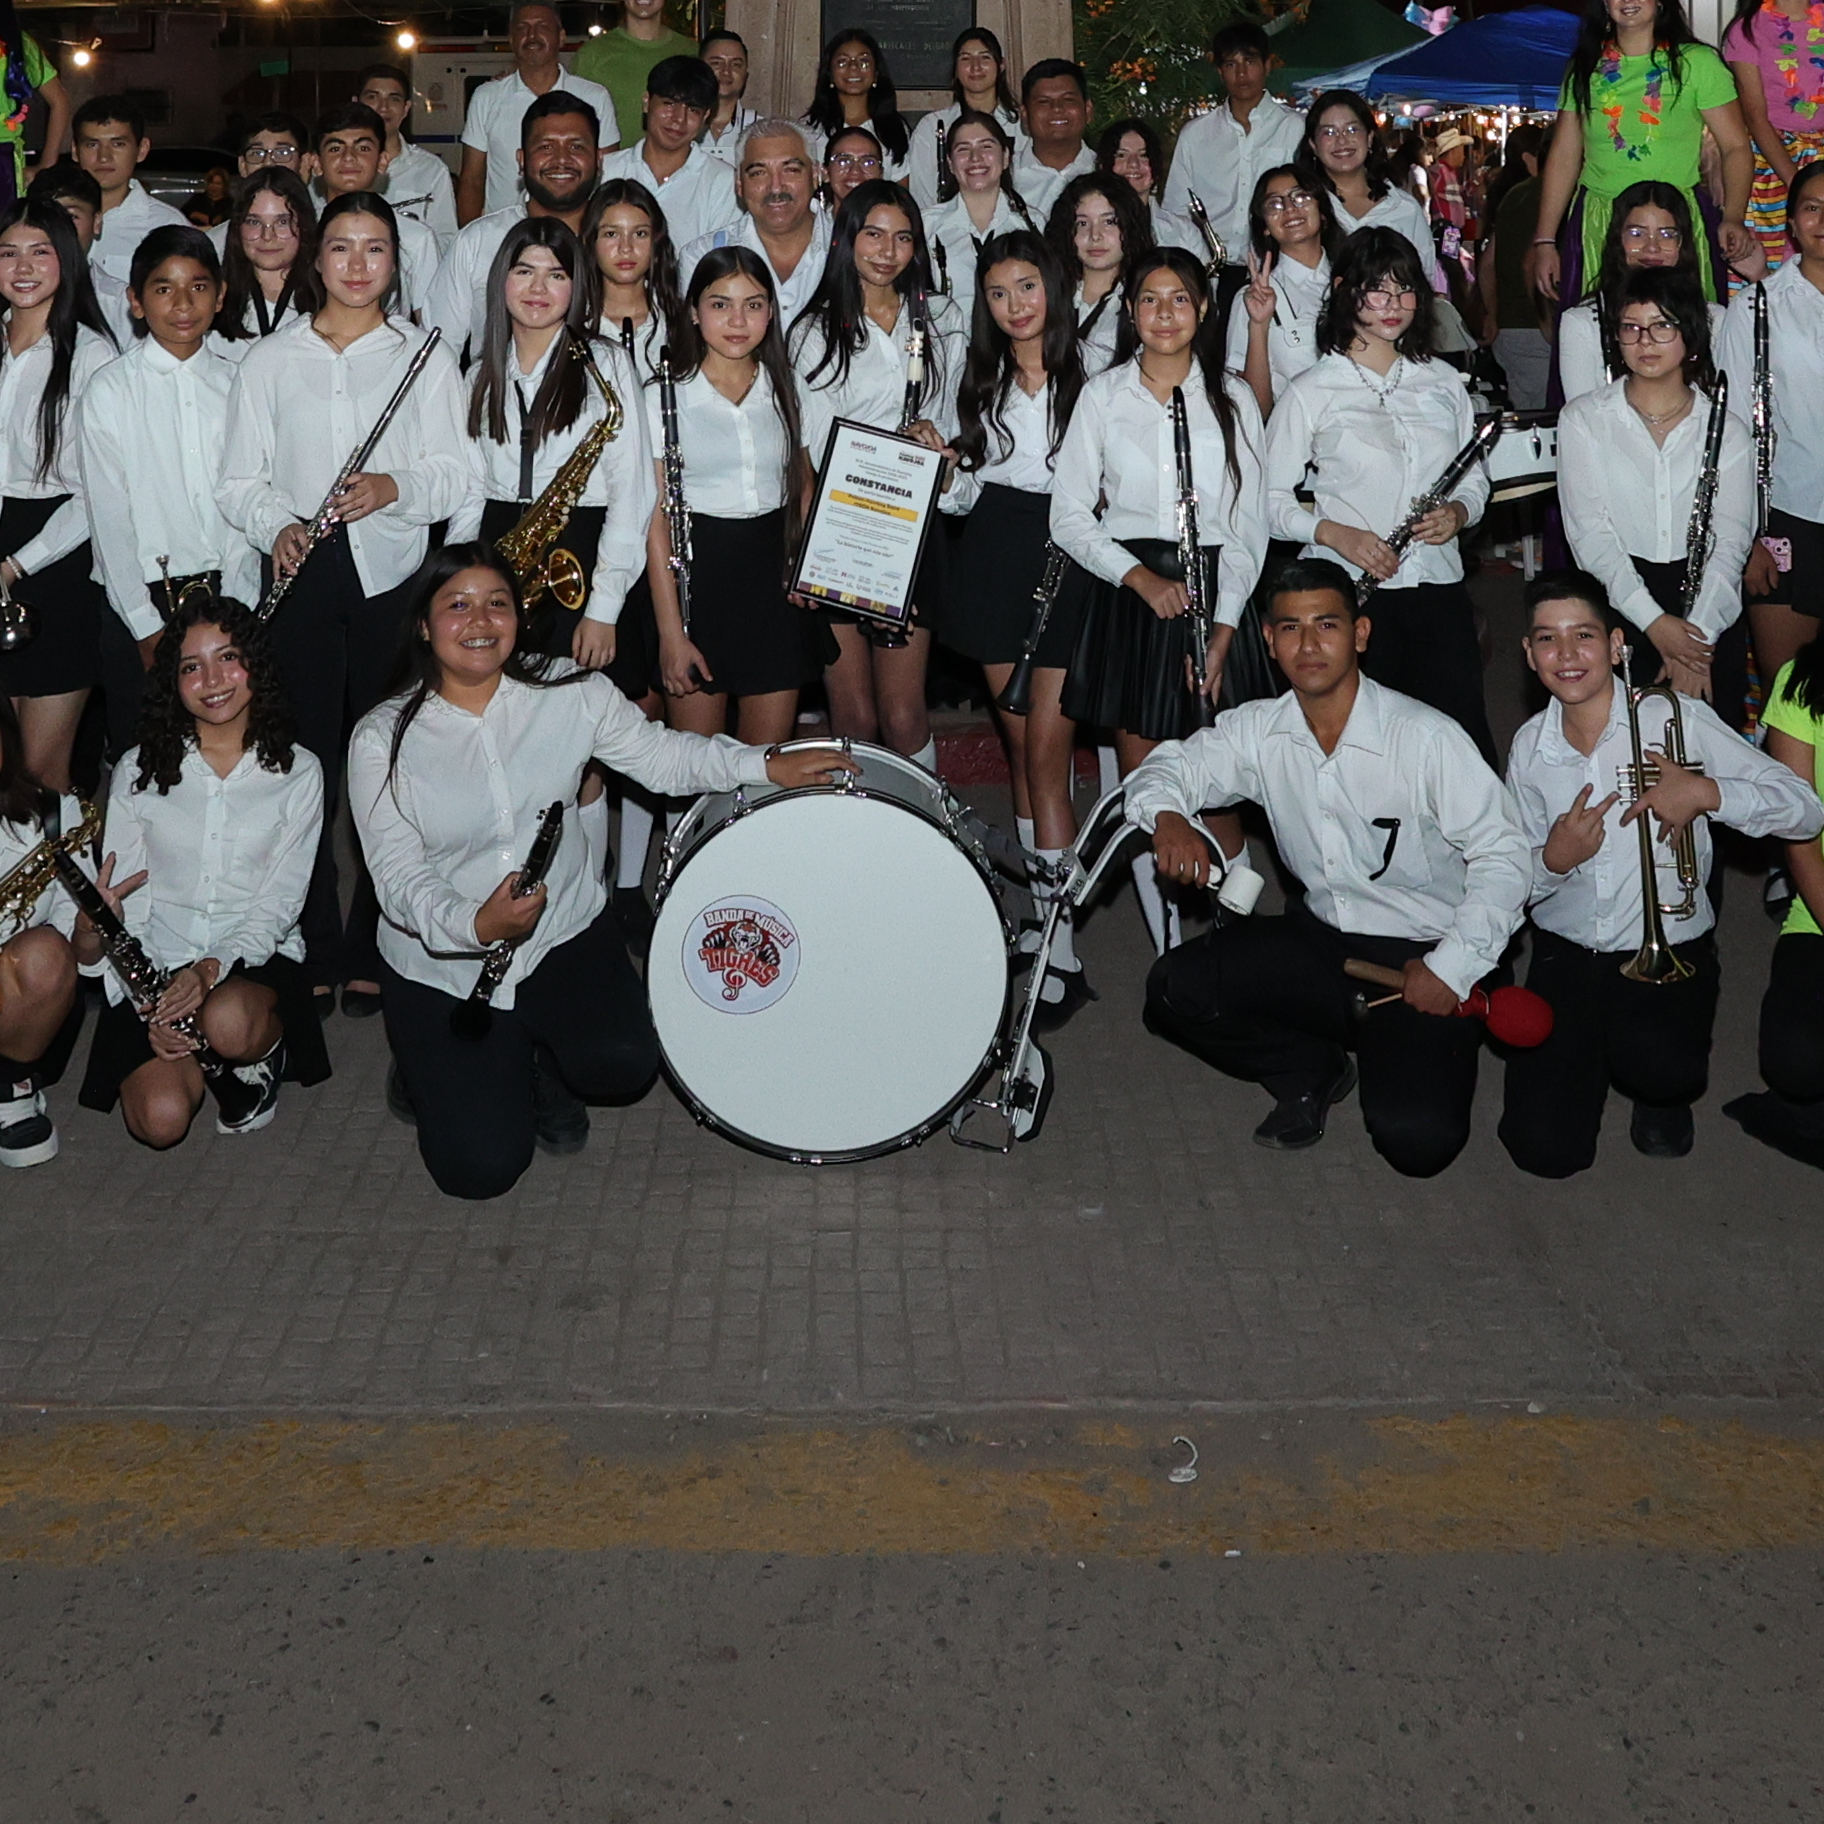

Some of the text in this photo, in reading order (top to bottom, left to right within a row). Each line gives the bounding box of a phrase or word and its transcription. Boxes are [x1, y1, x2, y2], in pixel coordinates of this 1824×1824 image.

[877, 41, 916, 50] ARISCALES
[845, 474, 913, 499] CONSTANCIA
[704, 908, 744, 927] BANDA
[698, 947, 780, 987] TIGRES
